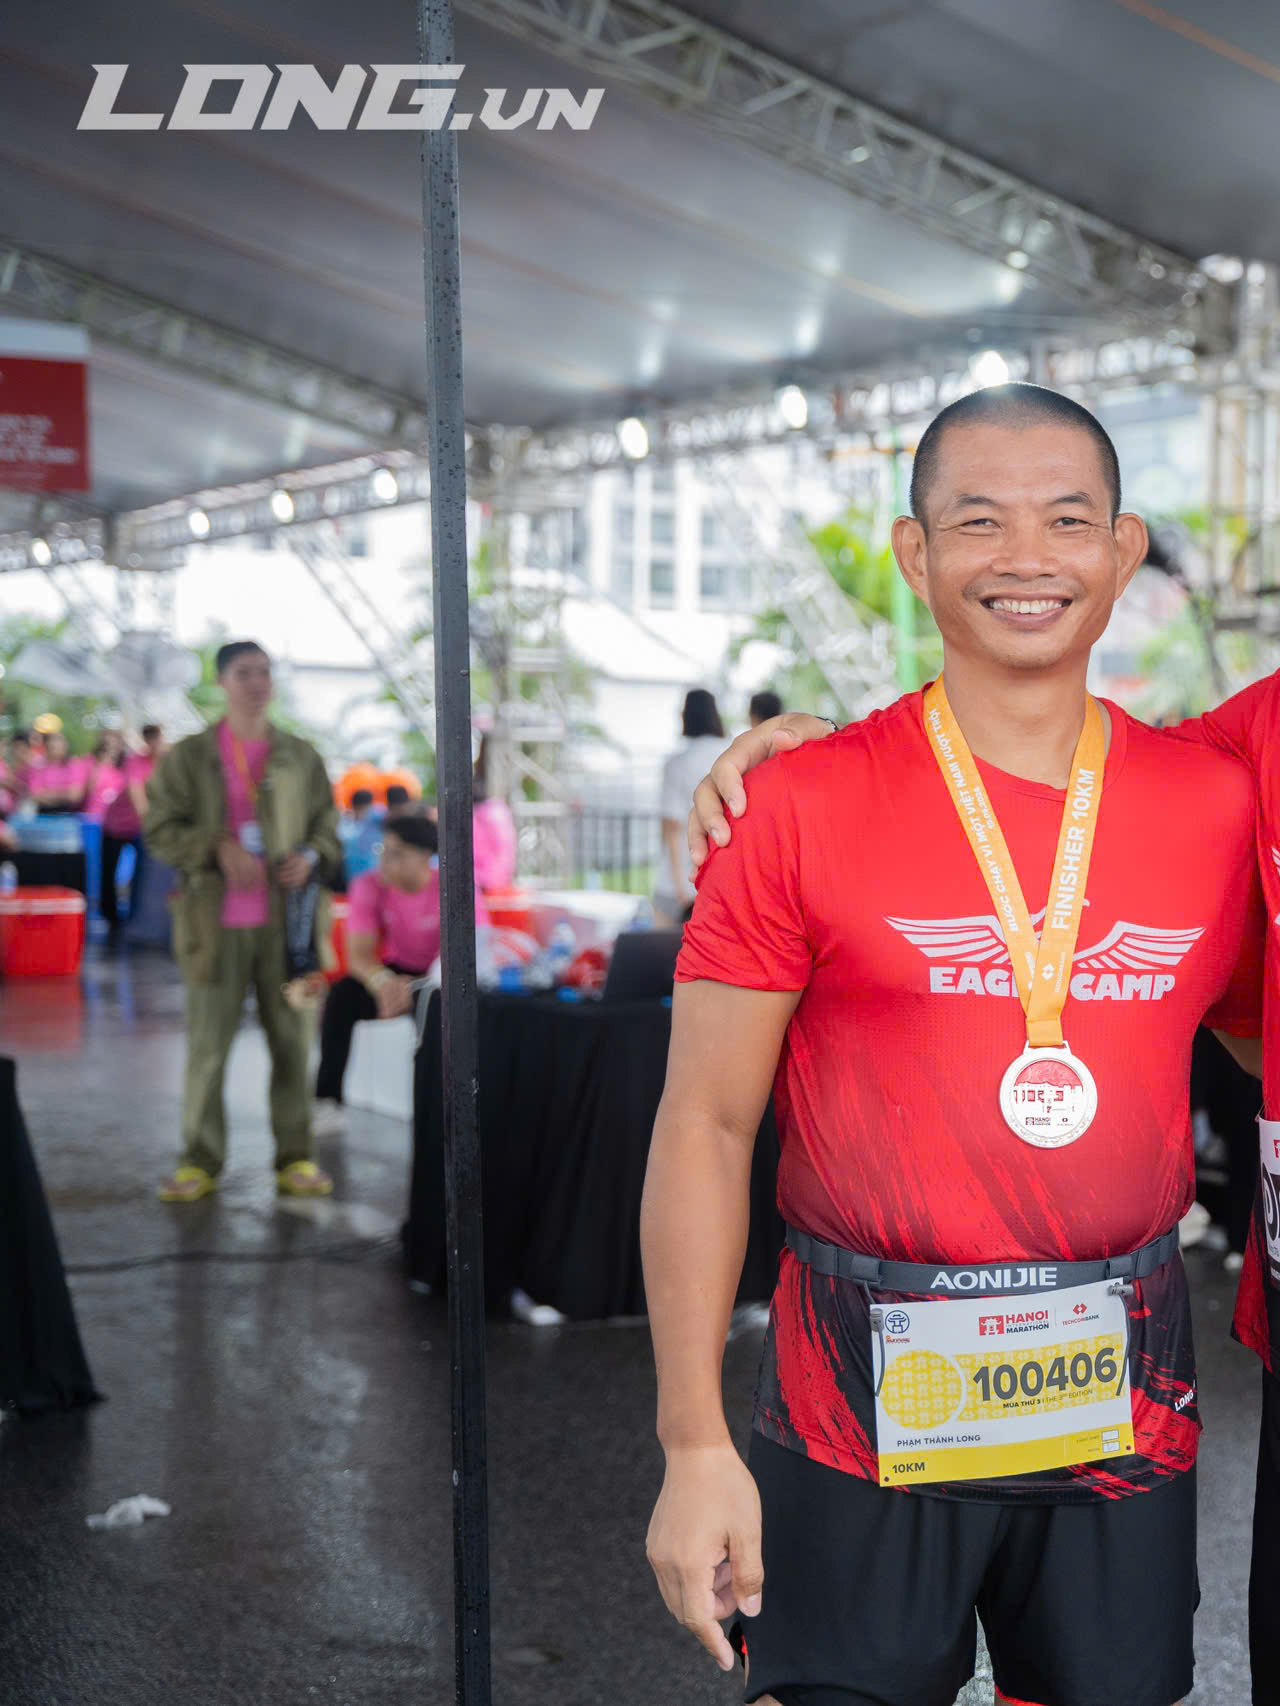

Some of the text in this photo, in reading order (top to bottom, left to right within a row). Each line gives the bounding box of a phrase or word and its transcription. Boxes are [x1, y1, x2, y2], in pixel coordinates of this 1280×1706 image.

[1051, 768, 1095, 929] FINISHER 10KM
[929, 967, 1176, 1001] EAG CAMP
[930, 1268, 1057, 1289] AONIJIE
[1005, 1310, 1049, 1323] HANOI
[1063, 1314, 1100, 1326] TECHCOMBANK
[1006, 1323, 1050, 1333] MARATHON
[973, 1347, 1118, 1401] 100406
[897, 1434, 981, 1448] PHẠM THÀNH LONG
[892, 1462, 926, 1473] 10KM
